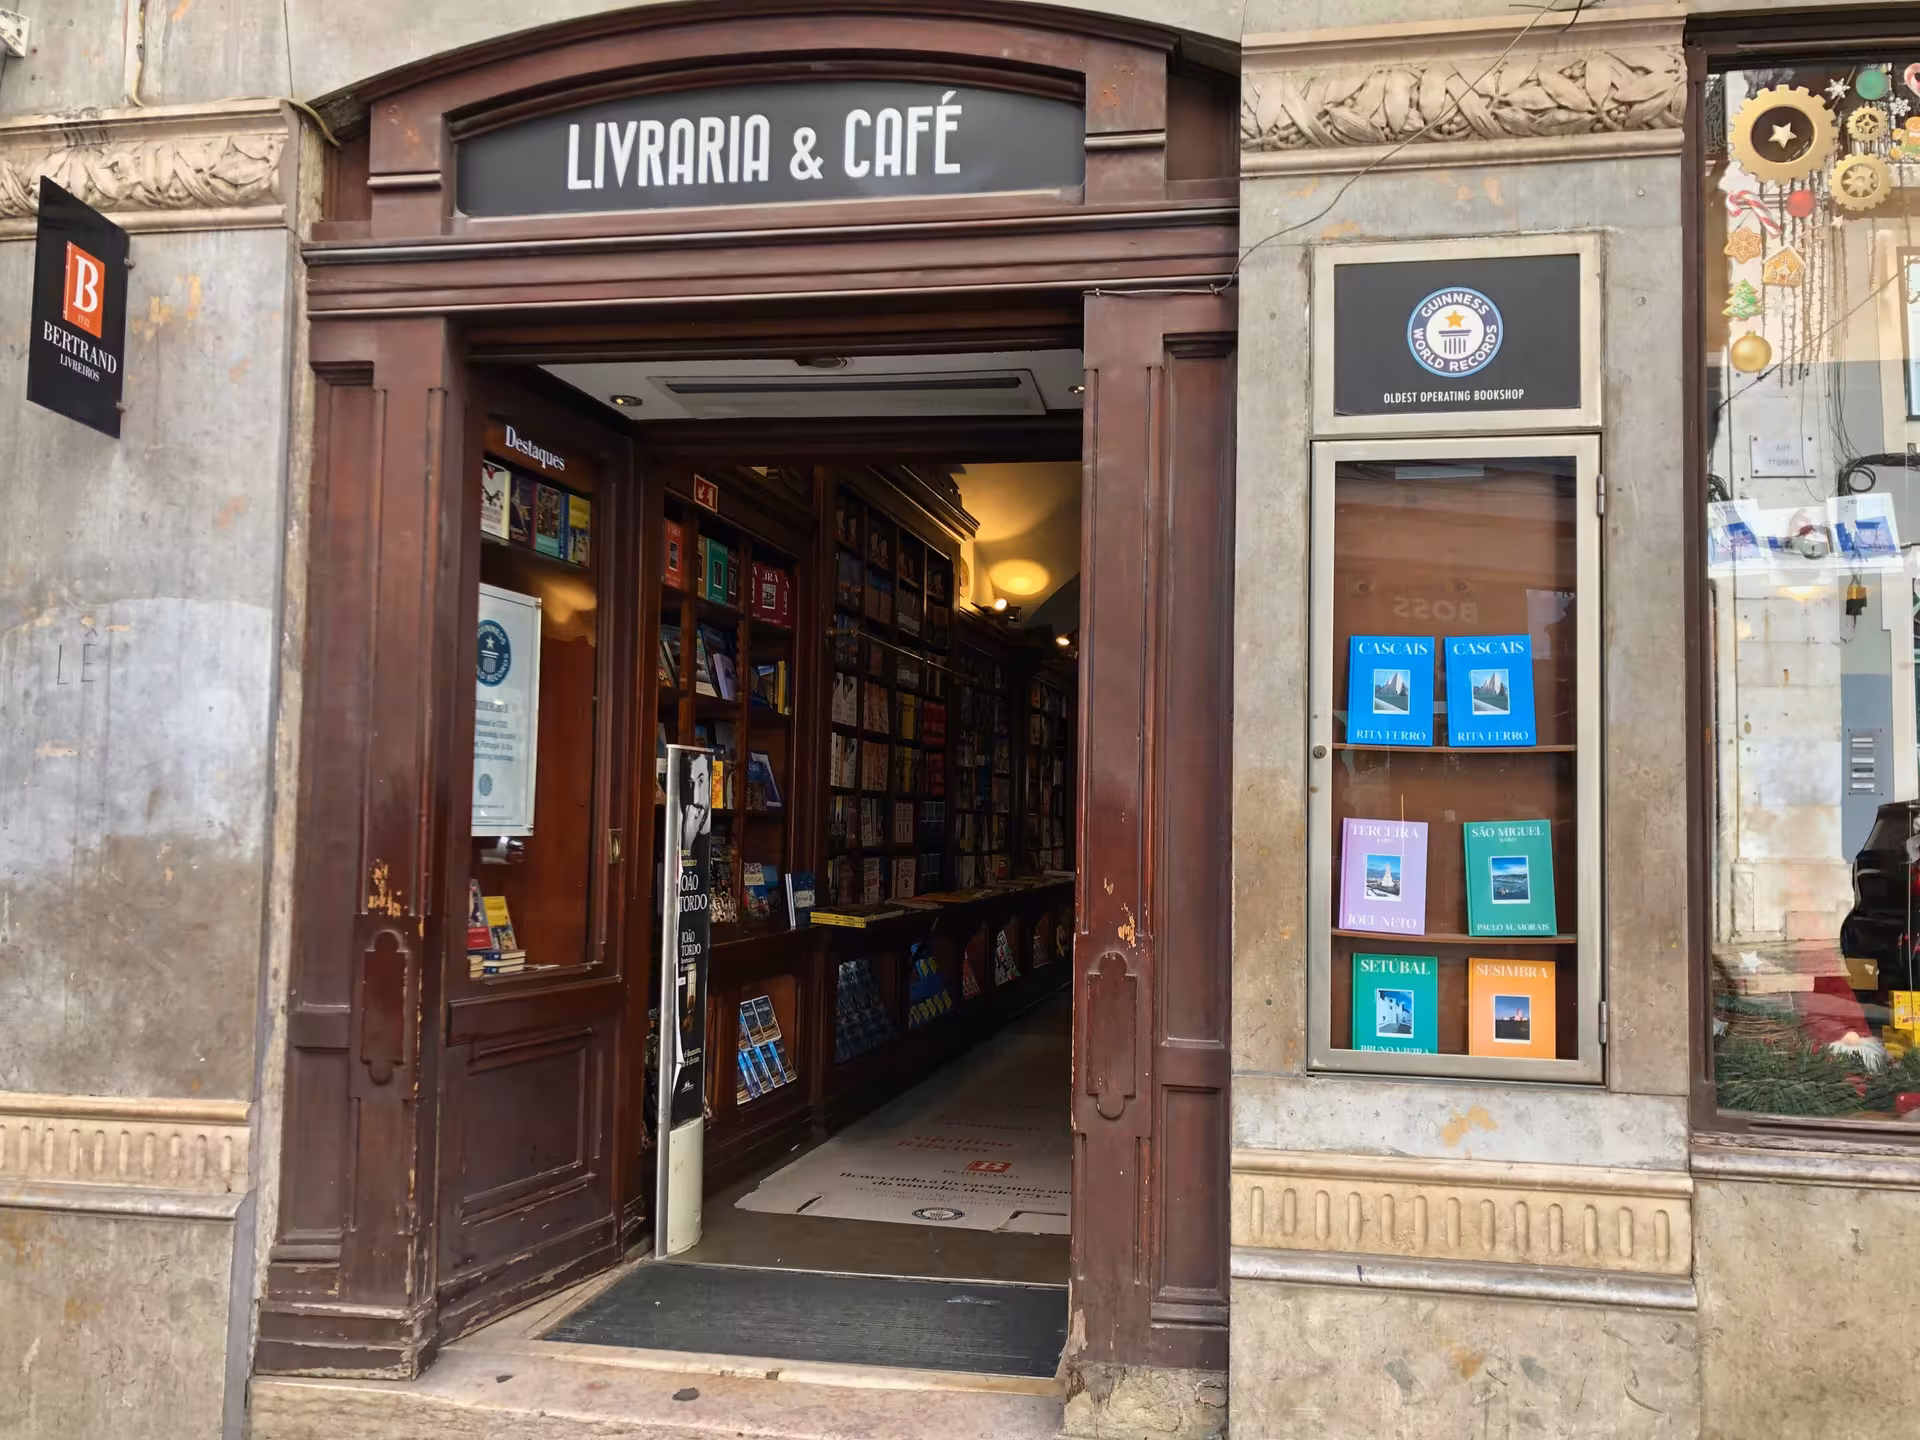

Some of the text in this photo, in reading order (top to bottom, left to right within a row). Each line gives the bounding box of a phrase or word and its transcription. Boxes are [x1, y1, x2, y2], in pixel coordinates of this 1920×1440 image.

[567, 90, 963, 190] LIVRARIA & CAFÉ
[72, 254, 99, 313] B
[1420, 293, 1490, 318] GUINNESS
[43, 319, 117, 375] BERTRAND
[1412, 324, 1497, 372] WORLD RECORDS
[59, 353, 100, 383] LIVREIROS
[1383, 388, 1525, 404] OLDEST OPERATING BOOKSHOP
[505, 424, 566, 471] Destaques
[1358, 641, 1429, 656] CASCAIS
[1453, 640, 1525, 656] CASCAIS
[1356, 729, 1426, 741] RITA FERRO
[1457, 730, 1529, 741] RITA FERRO
[1350, 823, 1419, 840] TERCEIRA
[1471, 825, 1544, 838] SÃO MIGUEL
[680, 870, 699, 892] OÃO
[680, 893, 708, 912] TORDO
[1382, 915, 1417, 929] NETO
[1477, 923, 1503, 932] PAULO
[1517, 923, 1550, 932] MORAIS
[681, 928, 696, 945] JOÃO
[681, 943, 702, 957] TORDO
[1360, 957, 1431, 975] SETÚBAL
[1475, 964, 1549, 979] SESIMBRA
